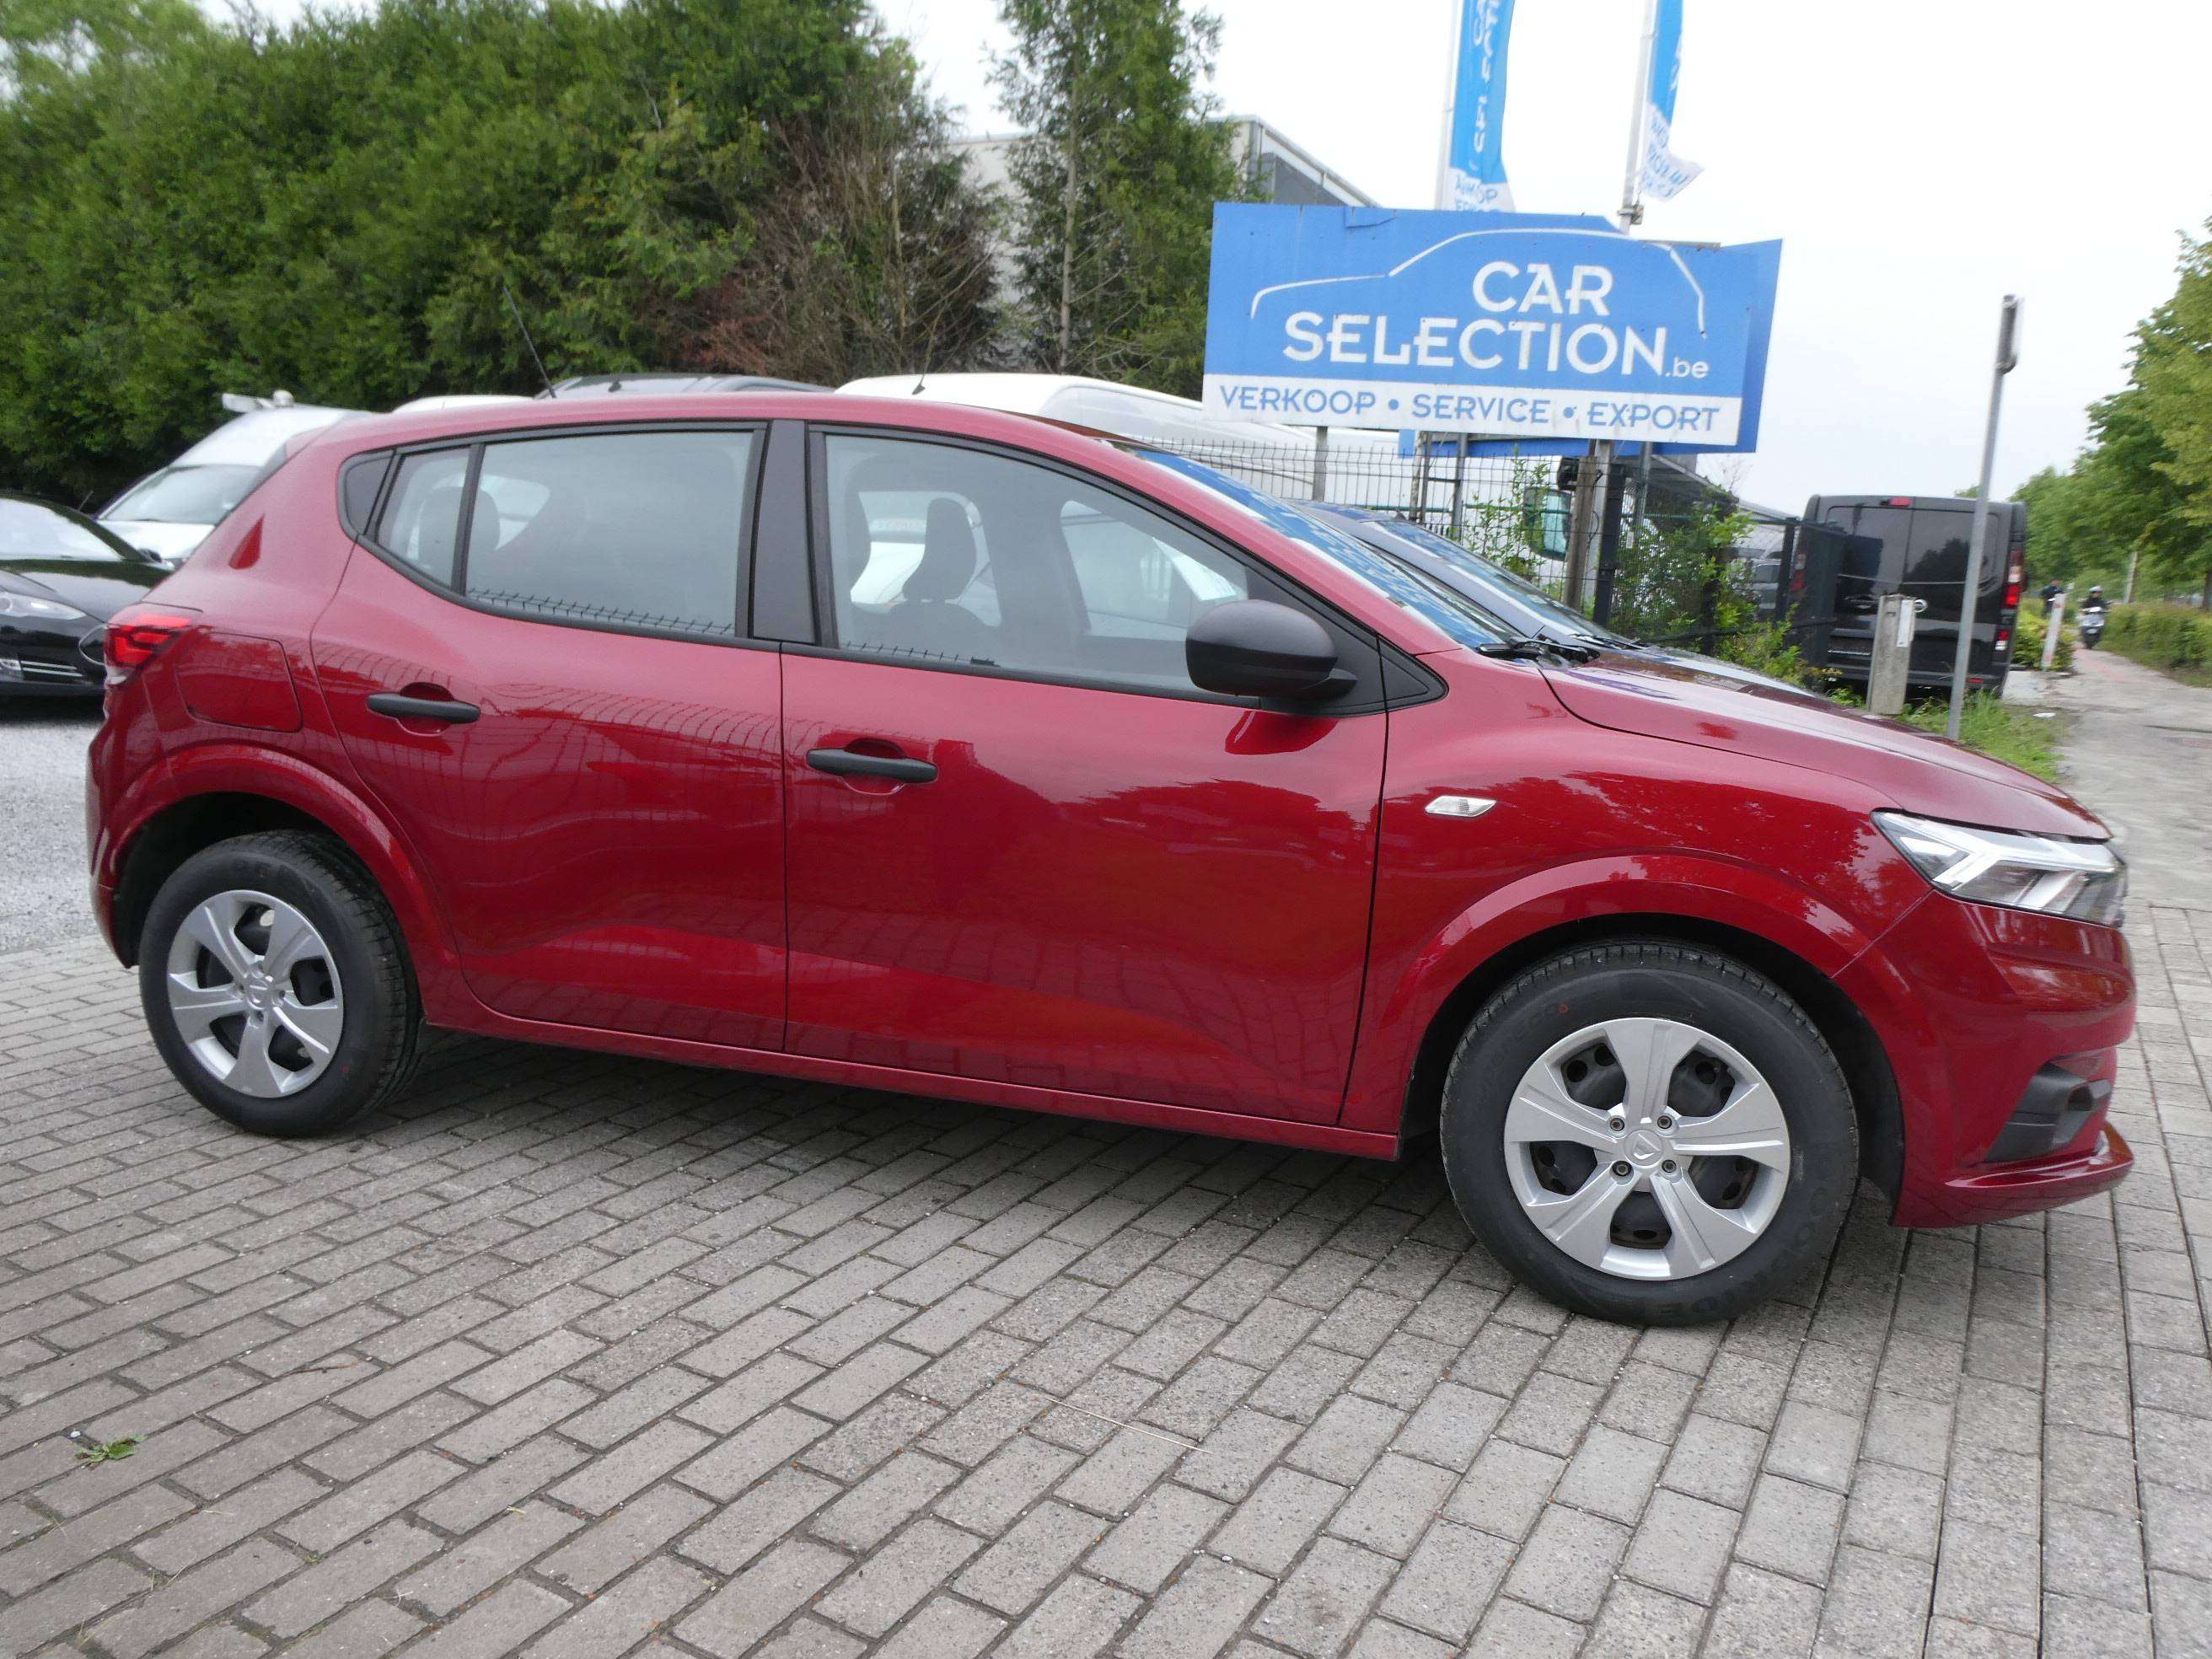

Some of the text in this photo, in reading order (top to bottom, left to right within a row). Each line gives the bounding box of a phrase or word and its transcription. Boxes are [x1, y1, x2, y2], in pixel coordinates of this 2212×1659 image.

[1473, 260, 1613, 315] CAR
[1221, 385, 1720, 432] VERKOOP SERVICE EXPORT
